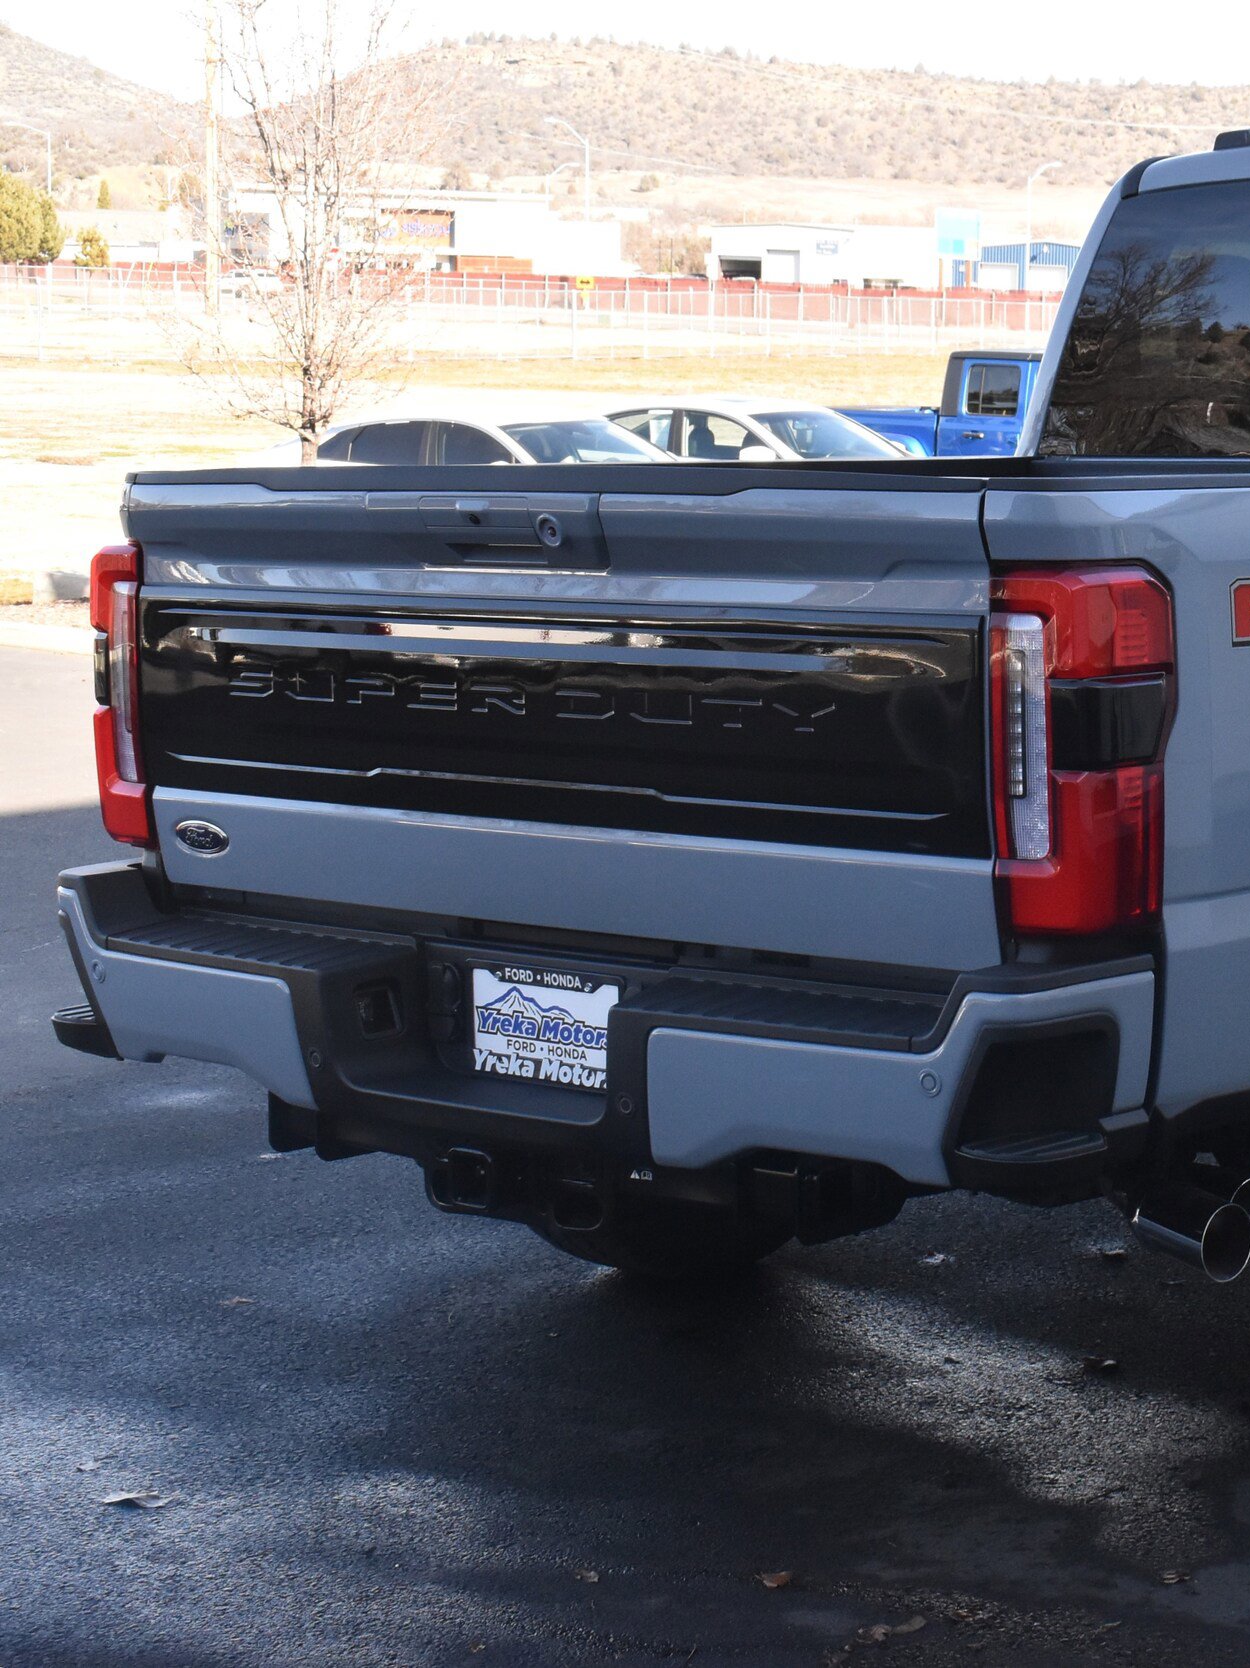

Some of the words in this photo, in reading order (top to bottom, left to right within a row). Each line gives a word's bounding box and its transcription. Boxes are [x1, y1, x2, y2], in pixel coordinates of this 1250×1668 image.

[229, 669, 525, 715] SUPER
[555, 689, 835, 732] DUTY
[504, 967, 533, 983] FORD
[543, 972, 582, 989] HONDA
[477, 1008, 538, 1039] Yreka
[473, 1048, 535, 1078] Yreka
[506, 1039, 536, 1054] FORD
[547, 1045, 587, 1061] HONDA
